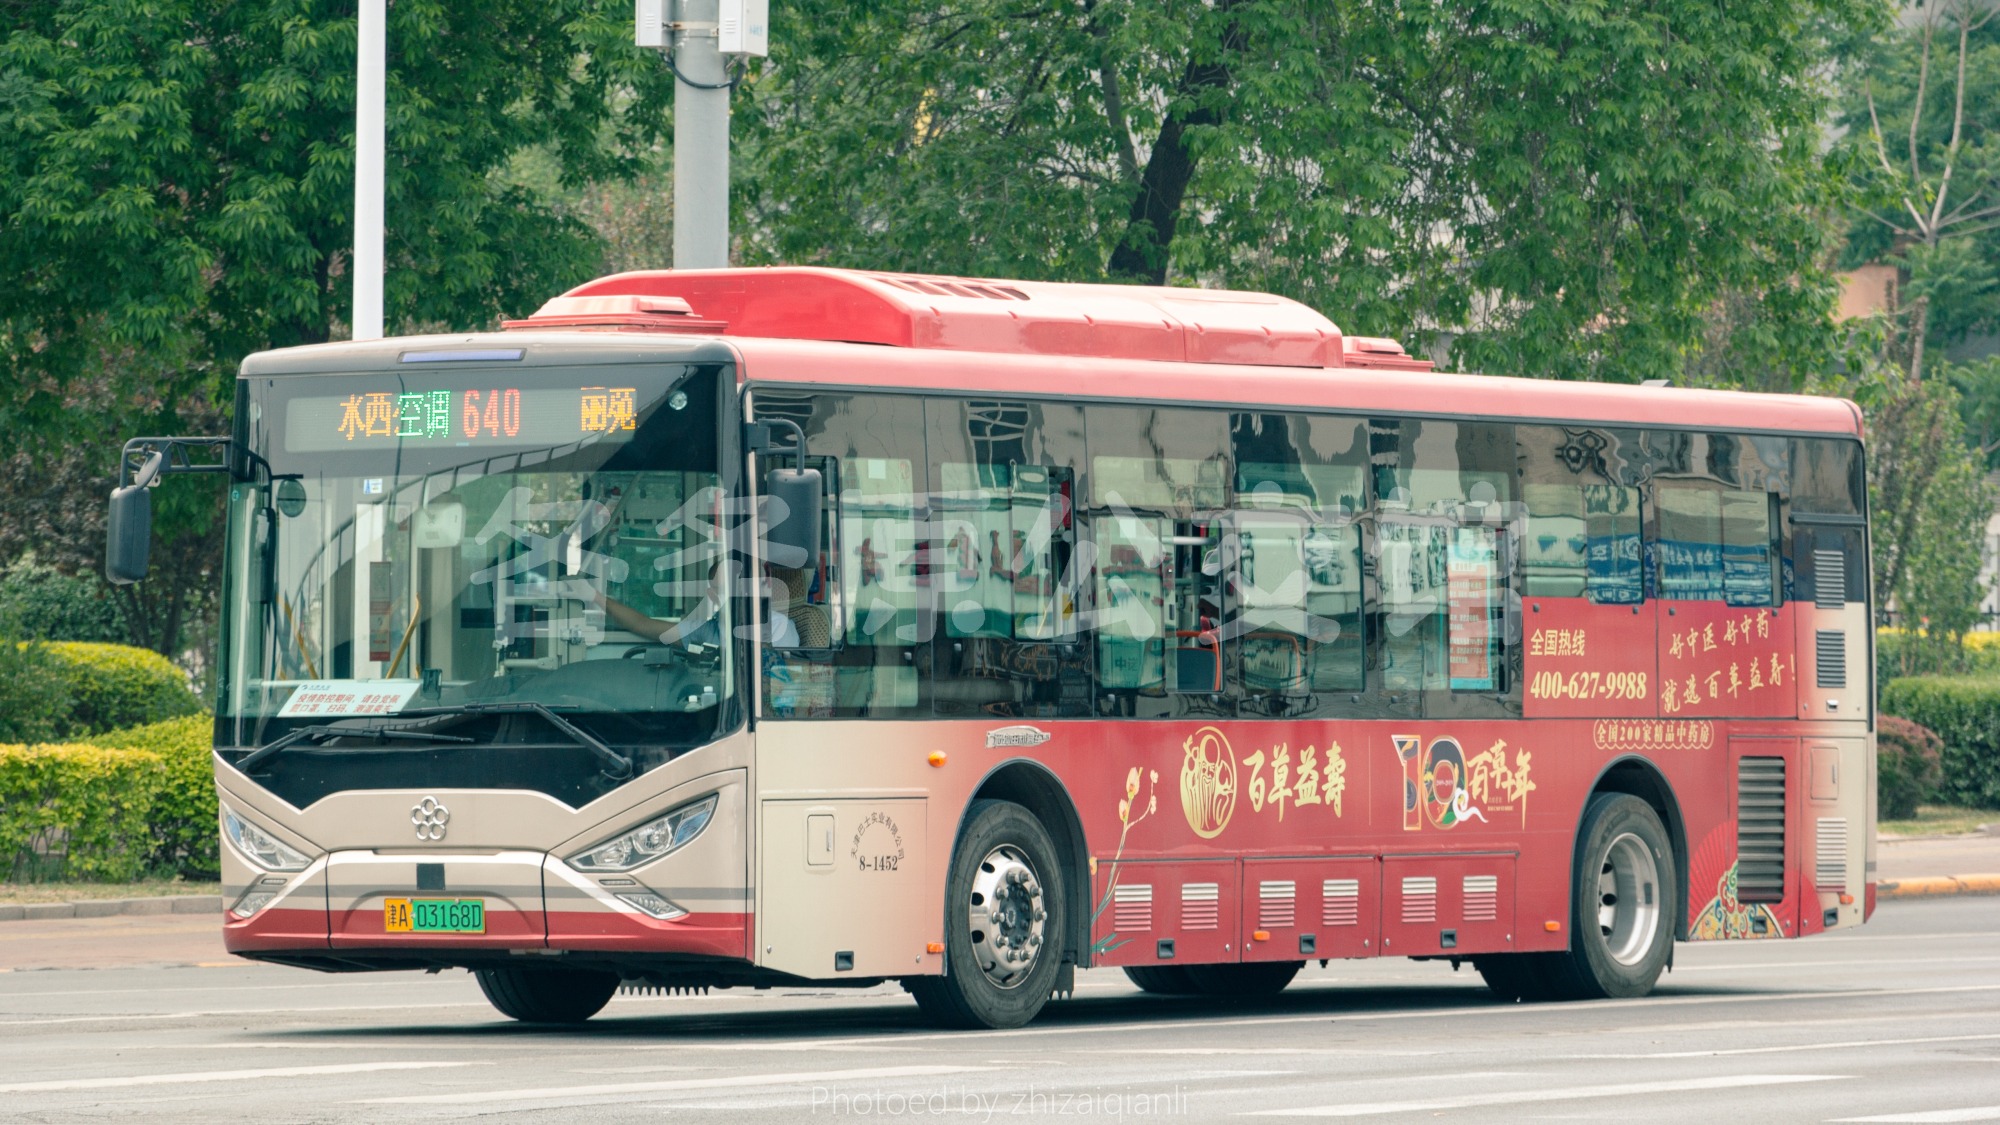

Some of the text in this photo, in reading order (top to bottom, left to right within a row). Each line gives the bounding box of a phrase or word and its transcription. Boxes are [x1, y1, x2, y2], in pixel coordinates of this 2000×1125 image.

[338, 392, 400, 441] 水西
[396, 390, 451, 439] 空调
[462, 388, 520, 438] 640
[1530, 628, 1586, 657] 全国热线
[1669, 609, 1769, 659] 好中医 好中药
[1530, 671, 1647, 700] 400-627-9988
[1597, 723, 1710, 744] 全国200家精品中药房
[850, 811, 905, 861] 天津巴士实业有限公司
[859, 855, 898, 872] 8-1452
